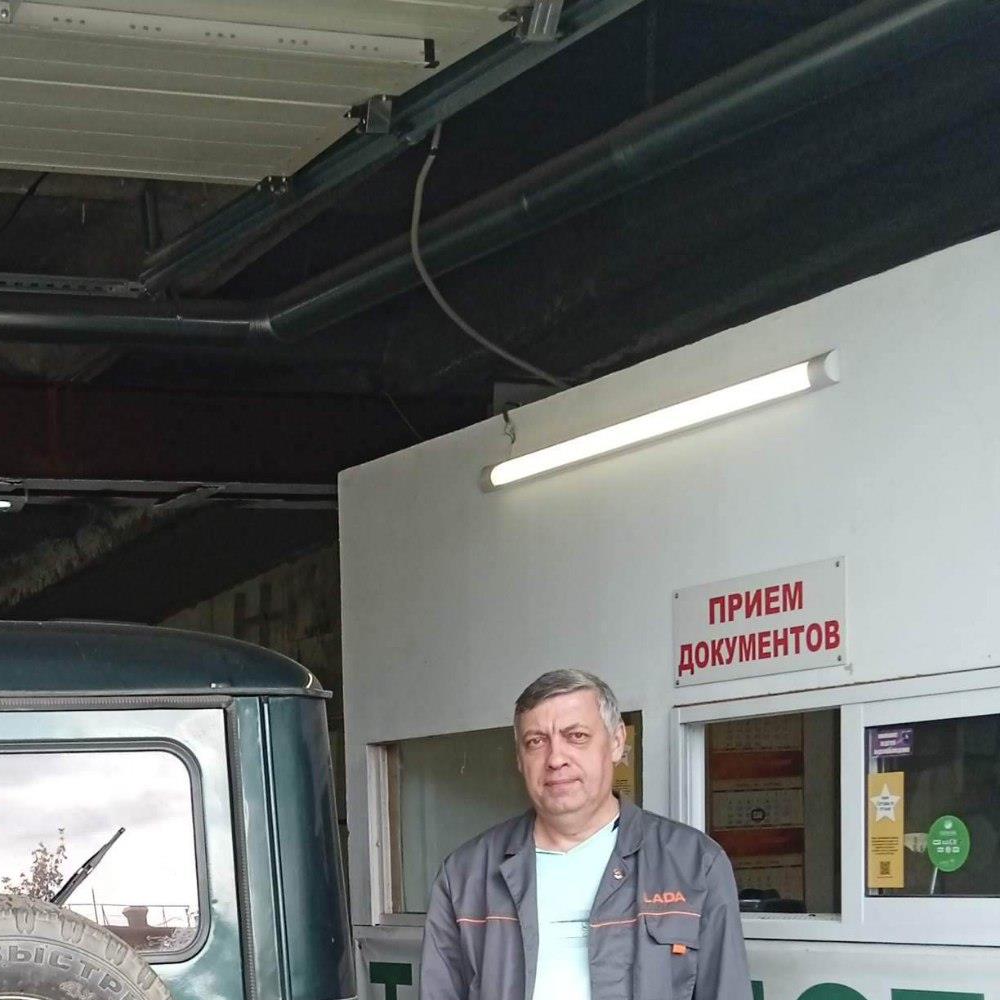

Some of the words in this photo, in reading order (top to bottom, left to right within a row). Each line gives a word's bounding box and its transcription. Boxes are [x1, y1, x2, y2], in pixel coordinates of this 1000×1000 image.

[708, 580, 804, 625] ПРИЕМ
[677, 619, 841, 677] ДОКУМЕНТОВ
[643, 891, 687, 904] LADA
